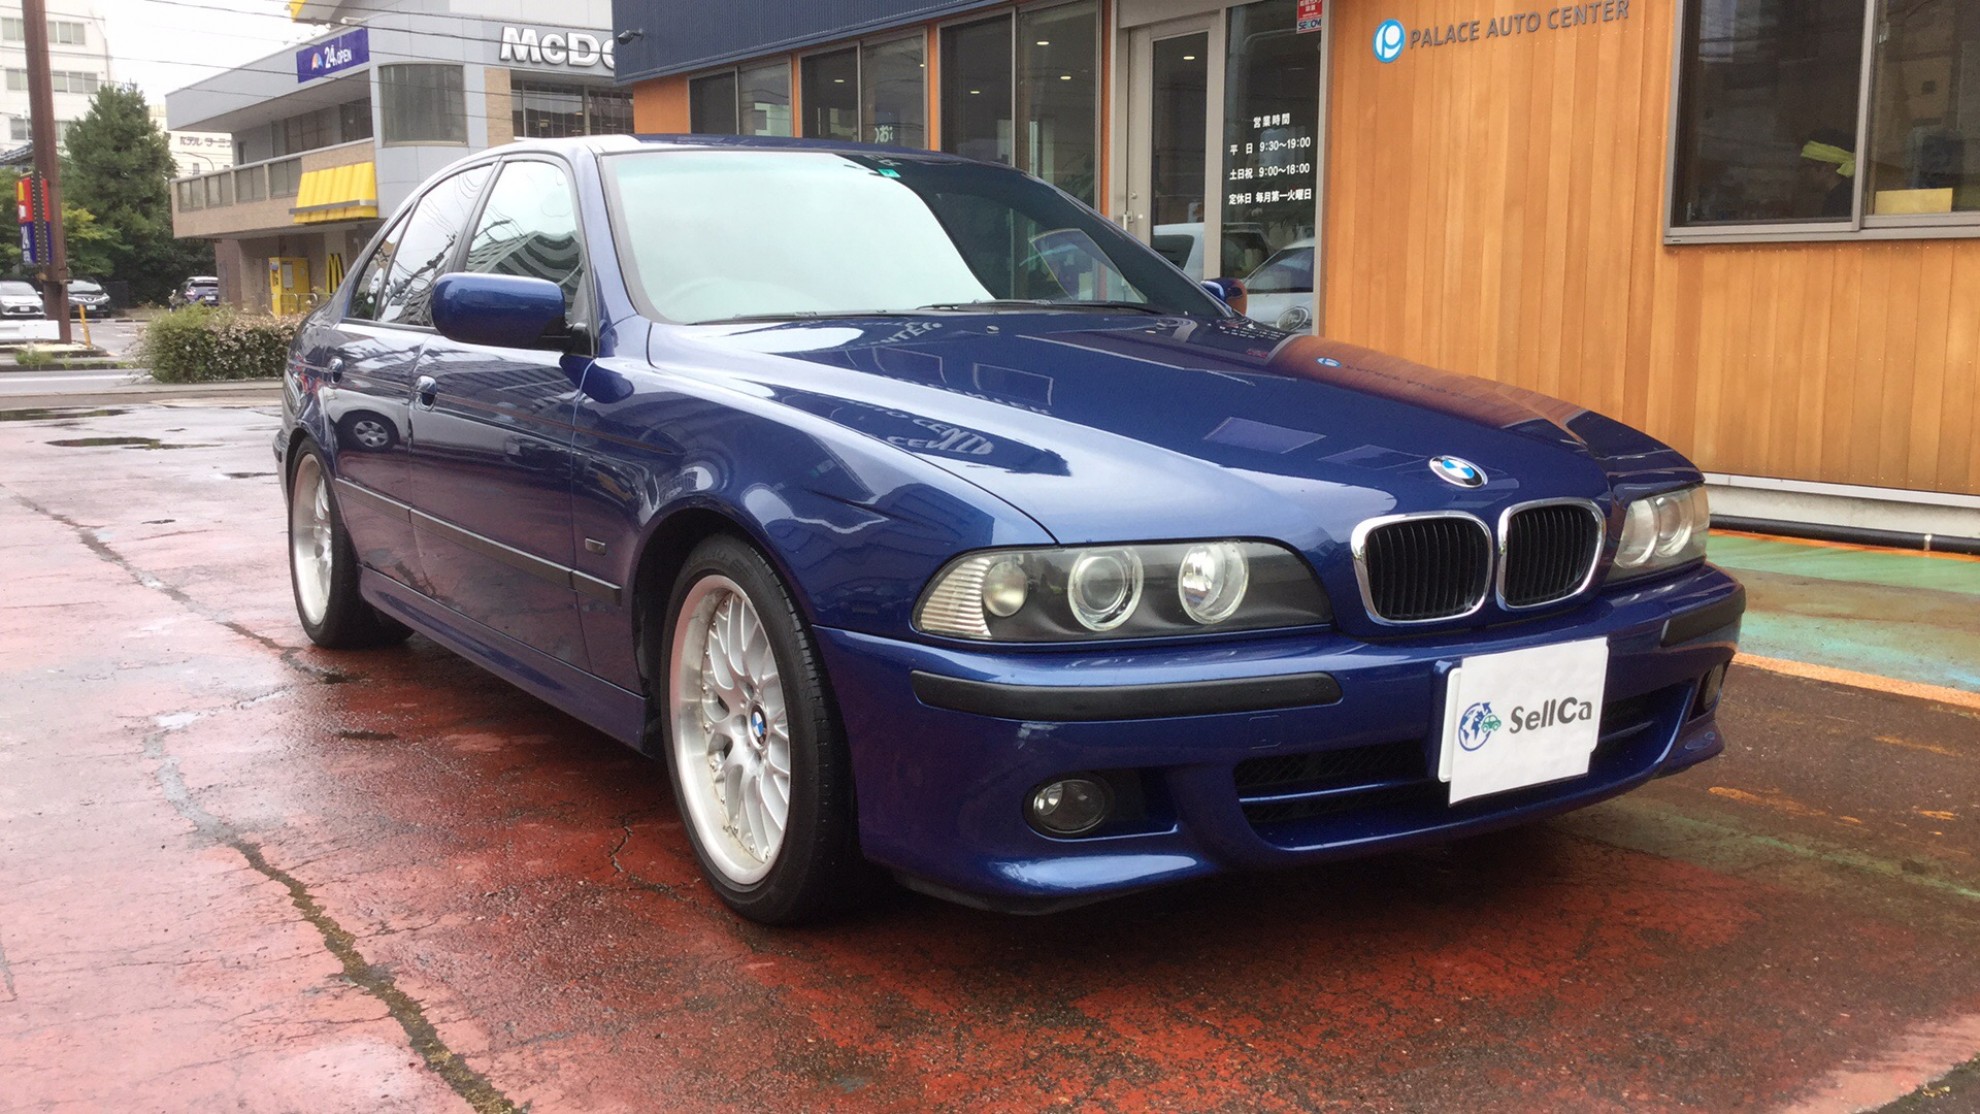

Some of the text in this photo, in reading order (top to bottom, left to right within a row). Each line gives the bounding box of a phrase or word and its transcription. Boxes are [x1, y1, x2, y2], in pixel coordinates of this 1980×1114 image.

[1410, 0, 1630, 49] PALACE AUTO CENTER
[1253, 112, 1291, 129] 営業時間
[1229, 167, 1254, 180] 土日祝
[1228, 188, 1312, 205] 定休日 毎月第一火曜日
[1509, 696, 1593, 734] SellCa
